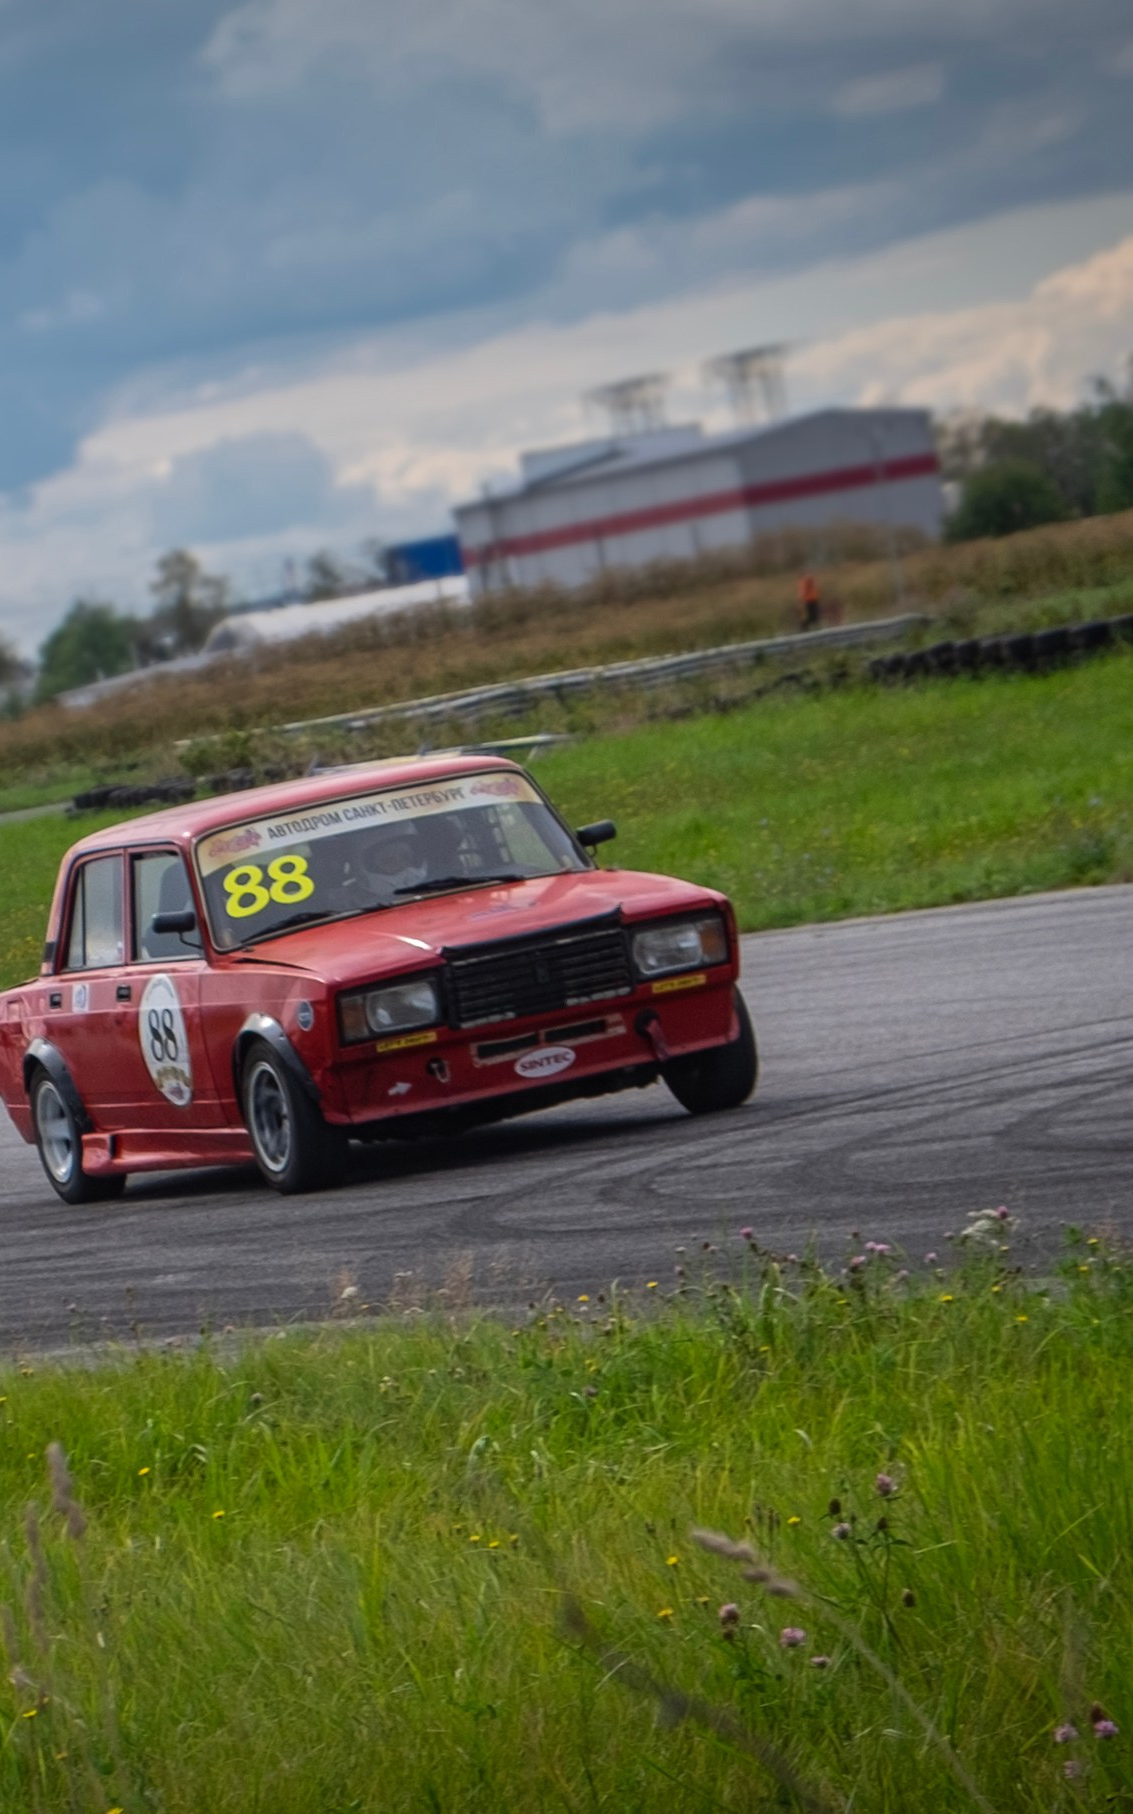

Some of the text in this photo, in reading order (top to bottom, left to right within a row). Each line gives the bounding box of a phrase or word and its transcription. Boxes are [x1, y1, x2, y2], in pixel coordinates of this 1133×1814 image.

[267, 812, 343, 840] АВТОДРОМ
[344, 786, 466, 822] САНКТ-ПЕТЕРБУРГ
[223, 854, 315, 918] 88
[148, 1008, 179, 1062] 88
[519, 1050, 571, 1072] SINTEC
